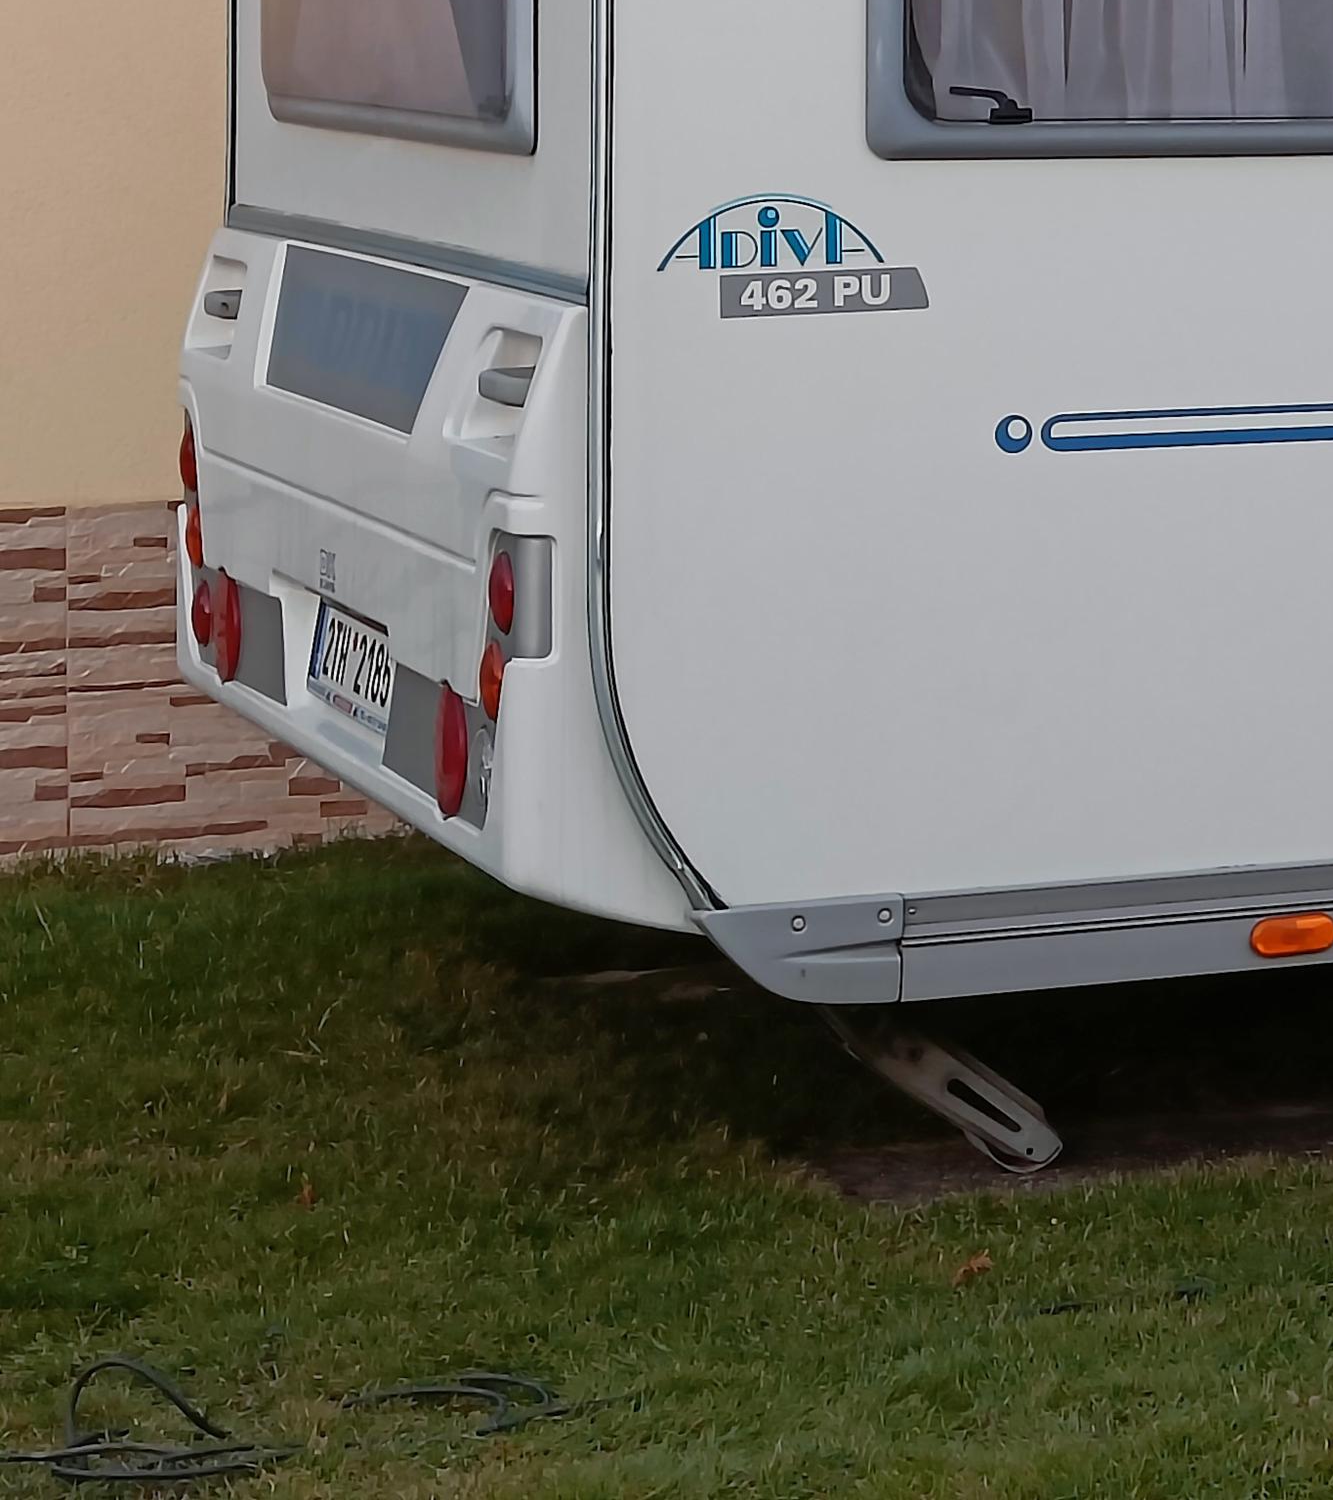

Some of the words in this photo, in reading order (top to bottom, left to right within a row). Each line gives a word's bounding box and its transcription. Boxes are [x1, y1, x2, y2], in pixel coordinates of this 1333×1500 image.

[740, 279, 818, 310] 462
[833, 274, 891, 306] PU
[322, 617, 352, 686] 2TH
